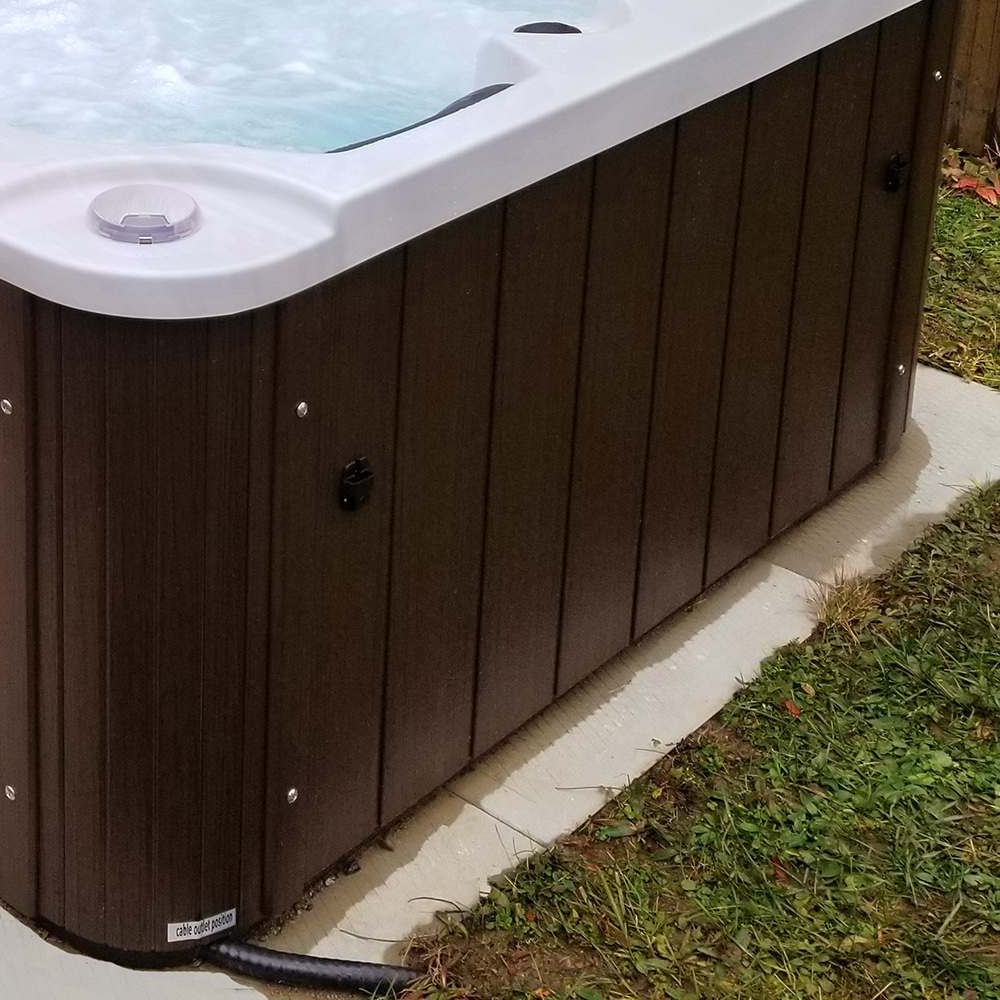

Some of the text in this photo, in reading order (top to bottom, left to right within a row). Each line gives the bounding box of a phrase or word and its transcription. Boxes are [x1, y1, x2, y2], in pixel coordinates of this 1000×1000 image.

[176, 912, 233, 937] cable outlet position
